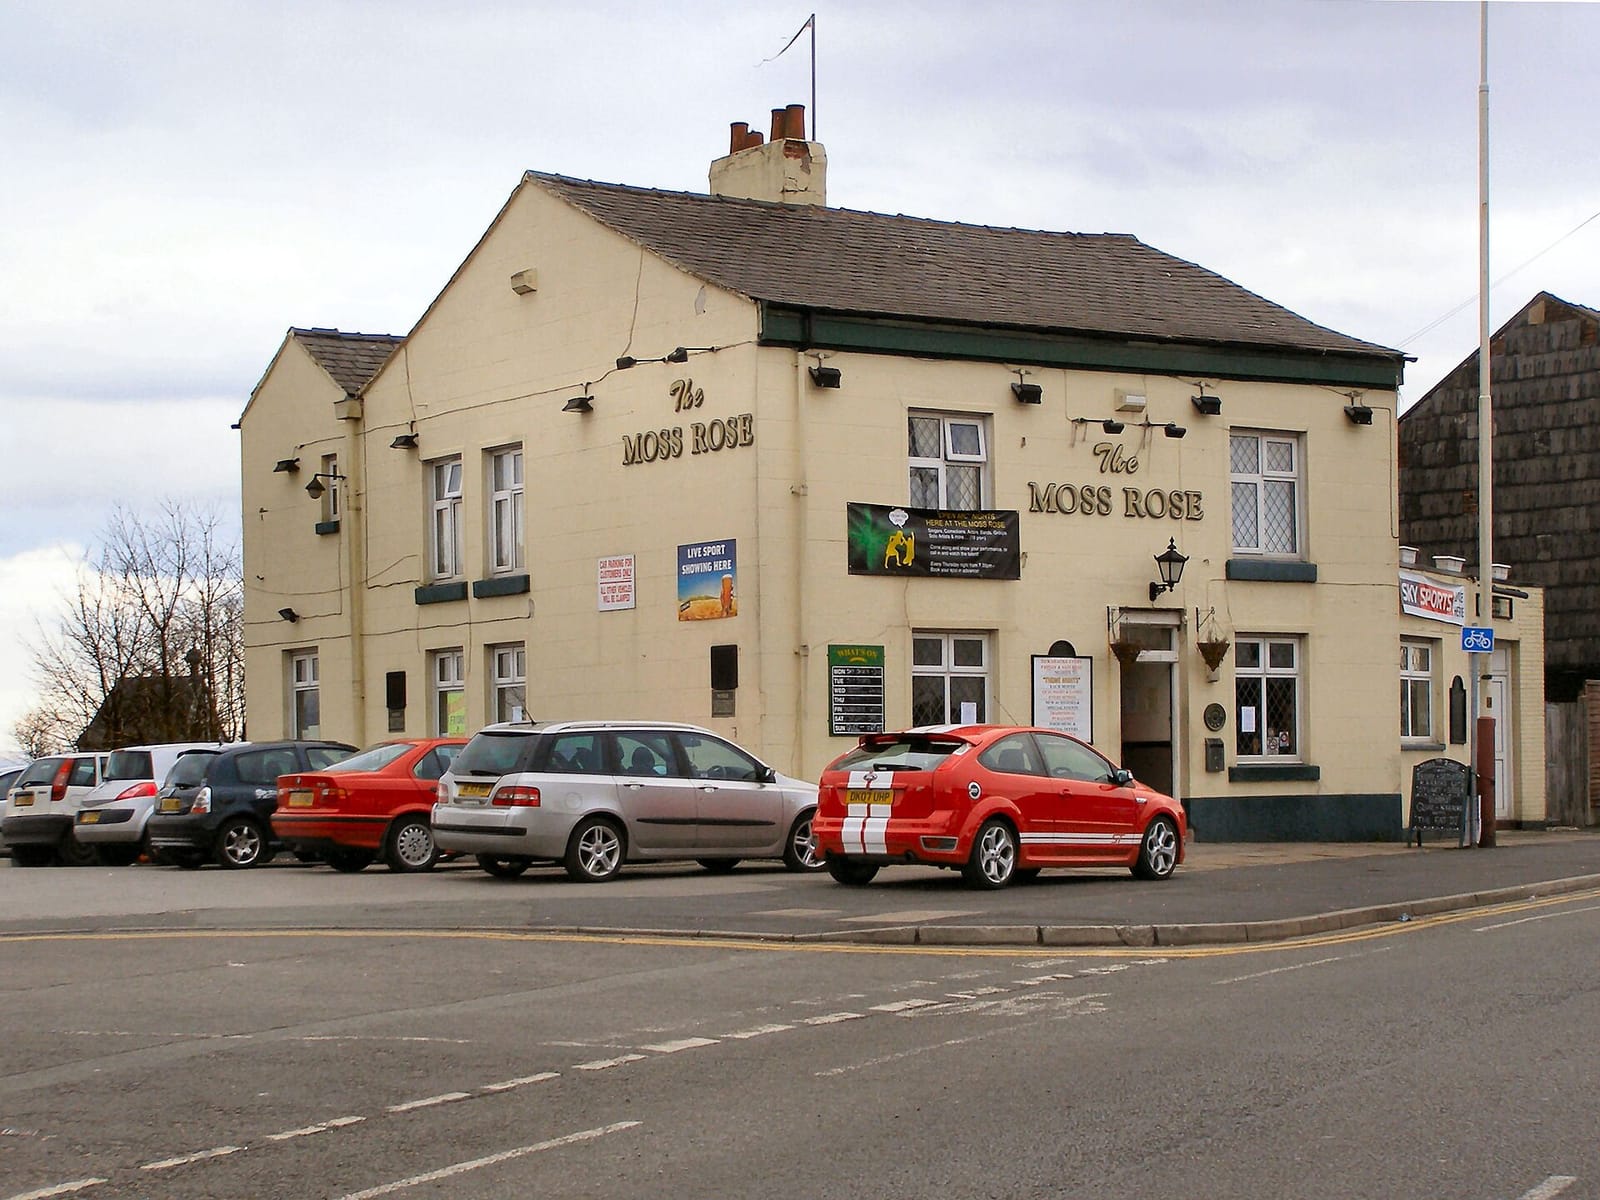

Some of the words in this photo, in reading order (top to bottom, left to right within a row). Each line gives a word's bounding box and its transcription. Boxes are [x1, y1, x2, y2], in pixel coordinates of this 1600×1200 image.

[669, 378, 704, 413] The
[622, 427, 683, 466] MOSS
[690, 413, 754, 455] ROSE
[1093, 442, 1139, 474] The
[1028, 481, 1113, 516] MOSS
[1123, 487, 1204, 521] ROSE
[971, 513, 996, 521] NIGHTS
[926, 519, 945, 527] HERE
[954, 520, 968, 528] THE
[968, 520, 987, 528] MOSS
[988, 521, 1006, 529] ROSE
[688, 547, 702, 558] LIVE
[703, 544, 726, 556] SPORT
[608, 559, 624, 568] PARKING
[682, 561, 712, 575] SHOWING
[713, 560, 732, 571] HERE
[600, 569, 621, 579] CUSTOMERS
[623, 568, 632, 578] ONLY
[607, 584, 617, 594] OTHER
[618, 584, 632, 593] VEHICLES
[616, 594, 630, 603] CLAMPED
[1401, 583, 1418, 604] SKY
[1420, 587, 1453, 612] SPORTS
[1454, 606, 1464, 618] HERE
[837, 648, 865, 657] WHAT'S
[866, 650, 878, 658] ON
[850, 791, 871, 801] DK07
